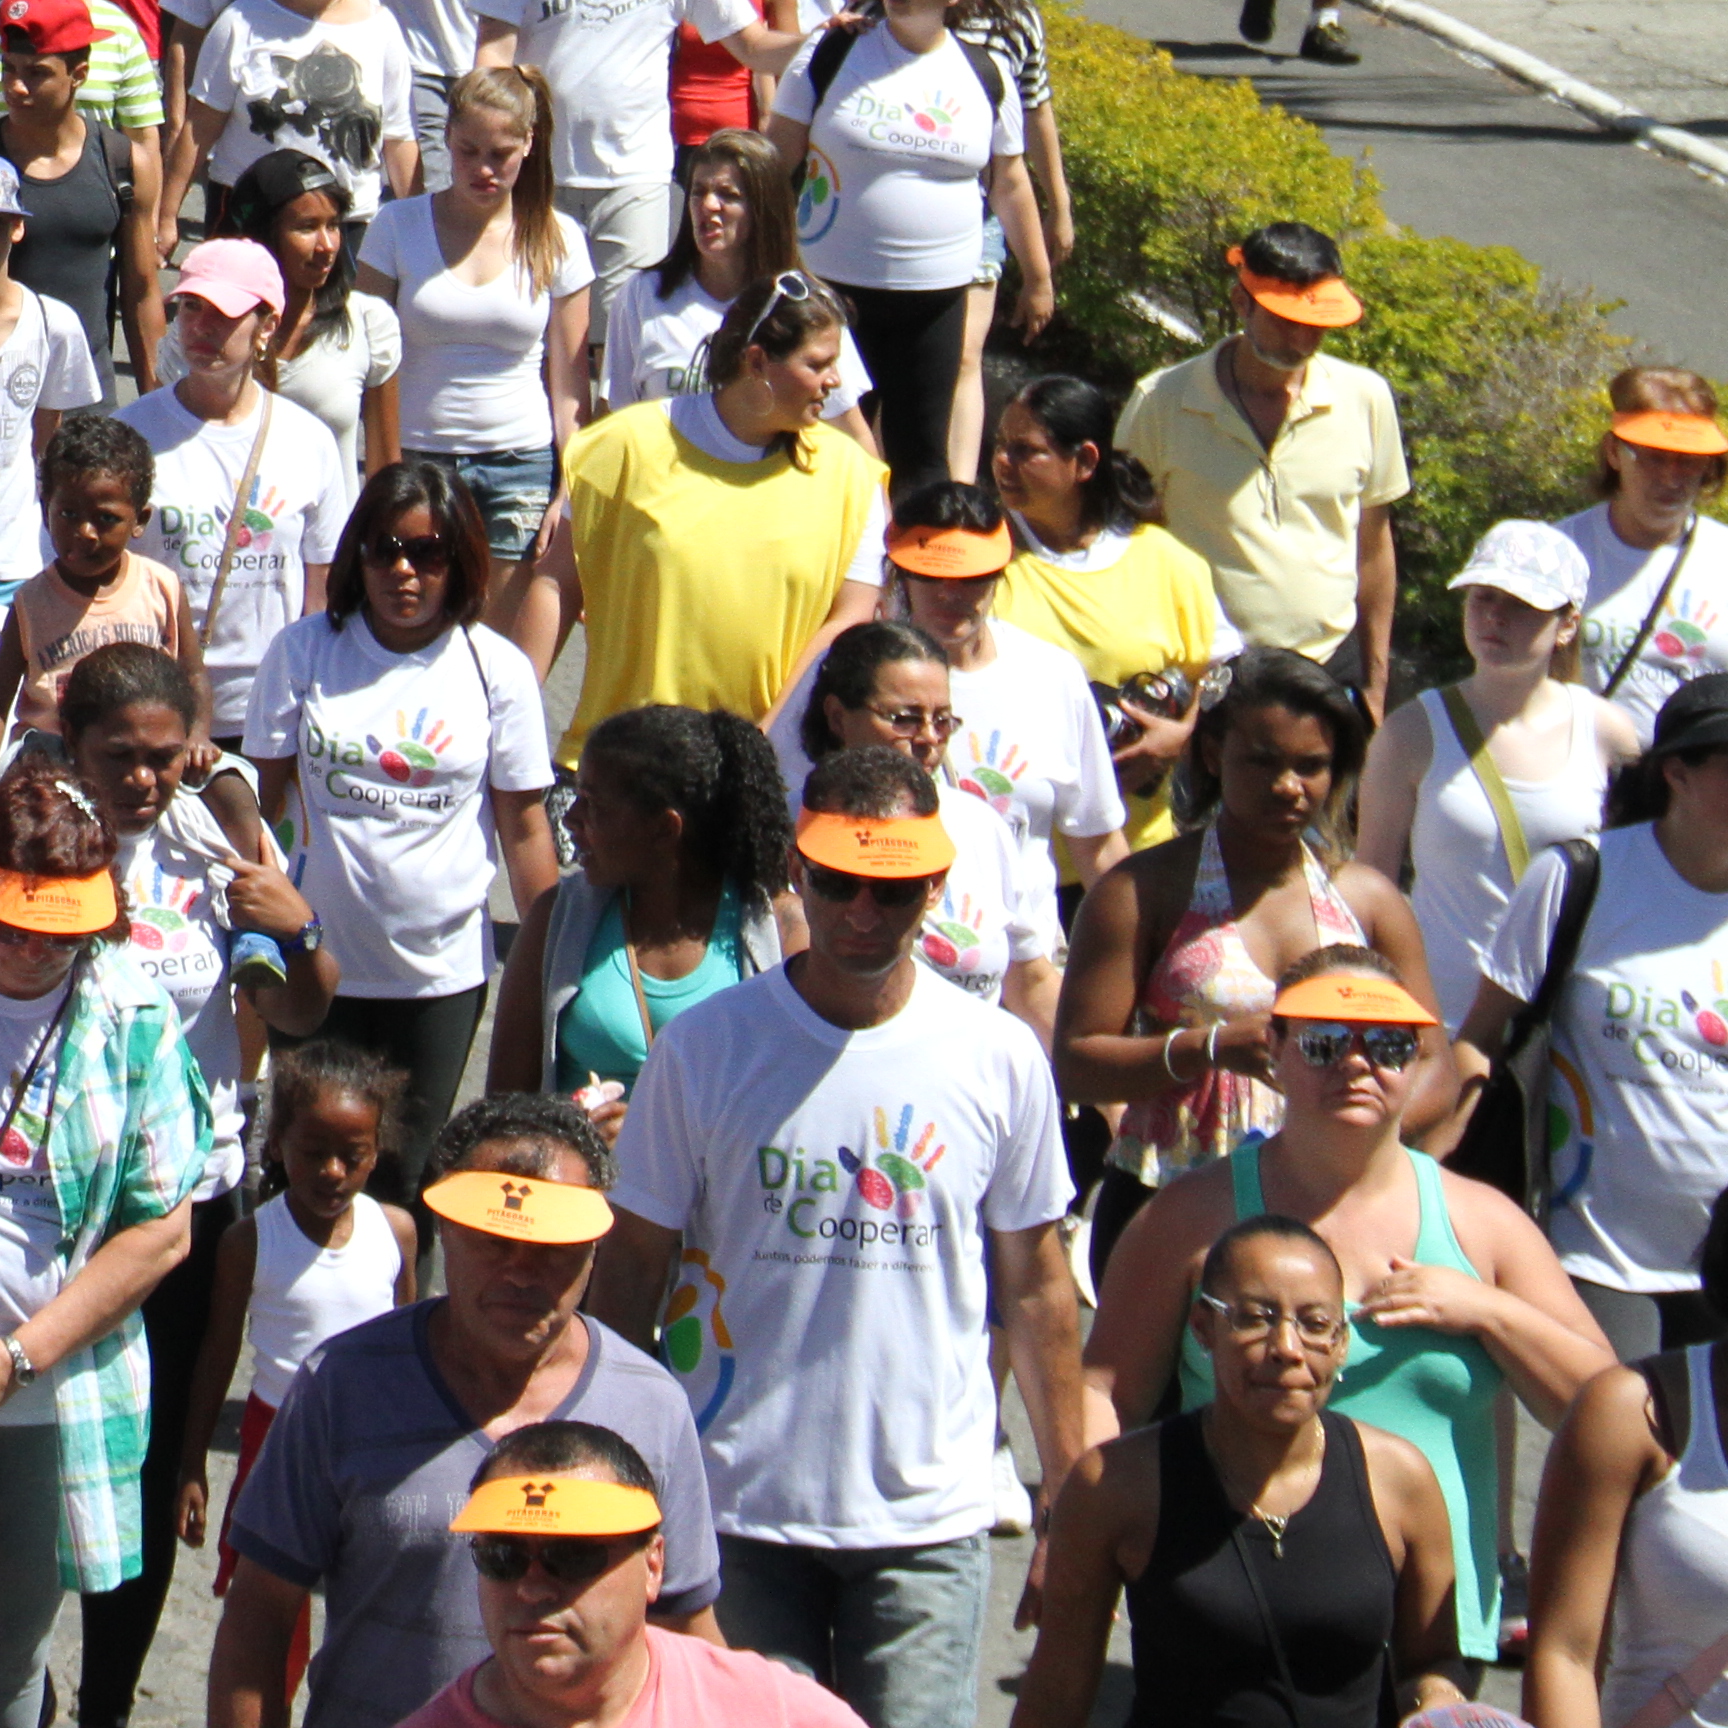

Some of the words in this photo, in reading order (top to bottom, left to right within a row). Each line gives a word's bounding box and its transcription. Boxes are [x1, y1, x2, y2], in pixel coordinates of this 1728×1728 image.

[856, 94, 905, 121] Dia
[869, 121, 969, 156] Cooperar
[160, 504, 215, 535] Dia
[164, 534, 181, 551] de
[306, 724, 365, 766] Dia
[325, 769, 453, 812] Cooperar
[141, 946, 220, 979] perar
[1606, 982, 1682, 1029] Dia
[1602, 1023, 1631, 1043] de
[1634, 1030, 1728, 1079] Coope
[757, 1145, 839, 1194] Dia
[763, 1191, 784, 1214] de
[786, 1197, 943, 1251] Cooperar
[752, 1249, 791, 1264] Juntos
[793, 1253, 848, 1269] podemos
